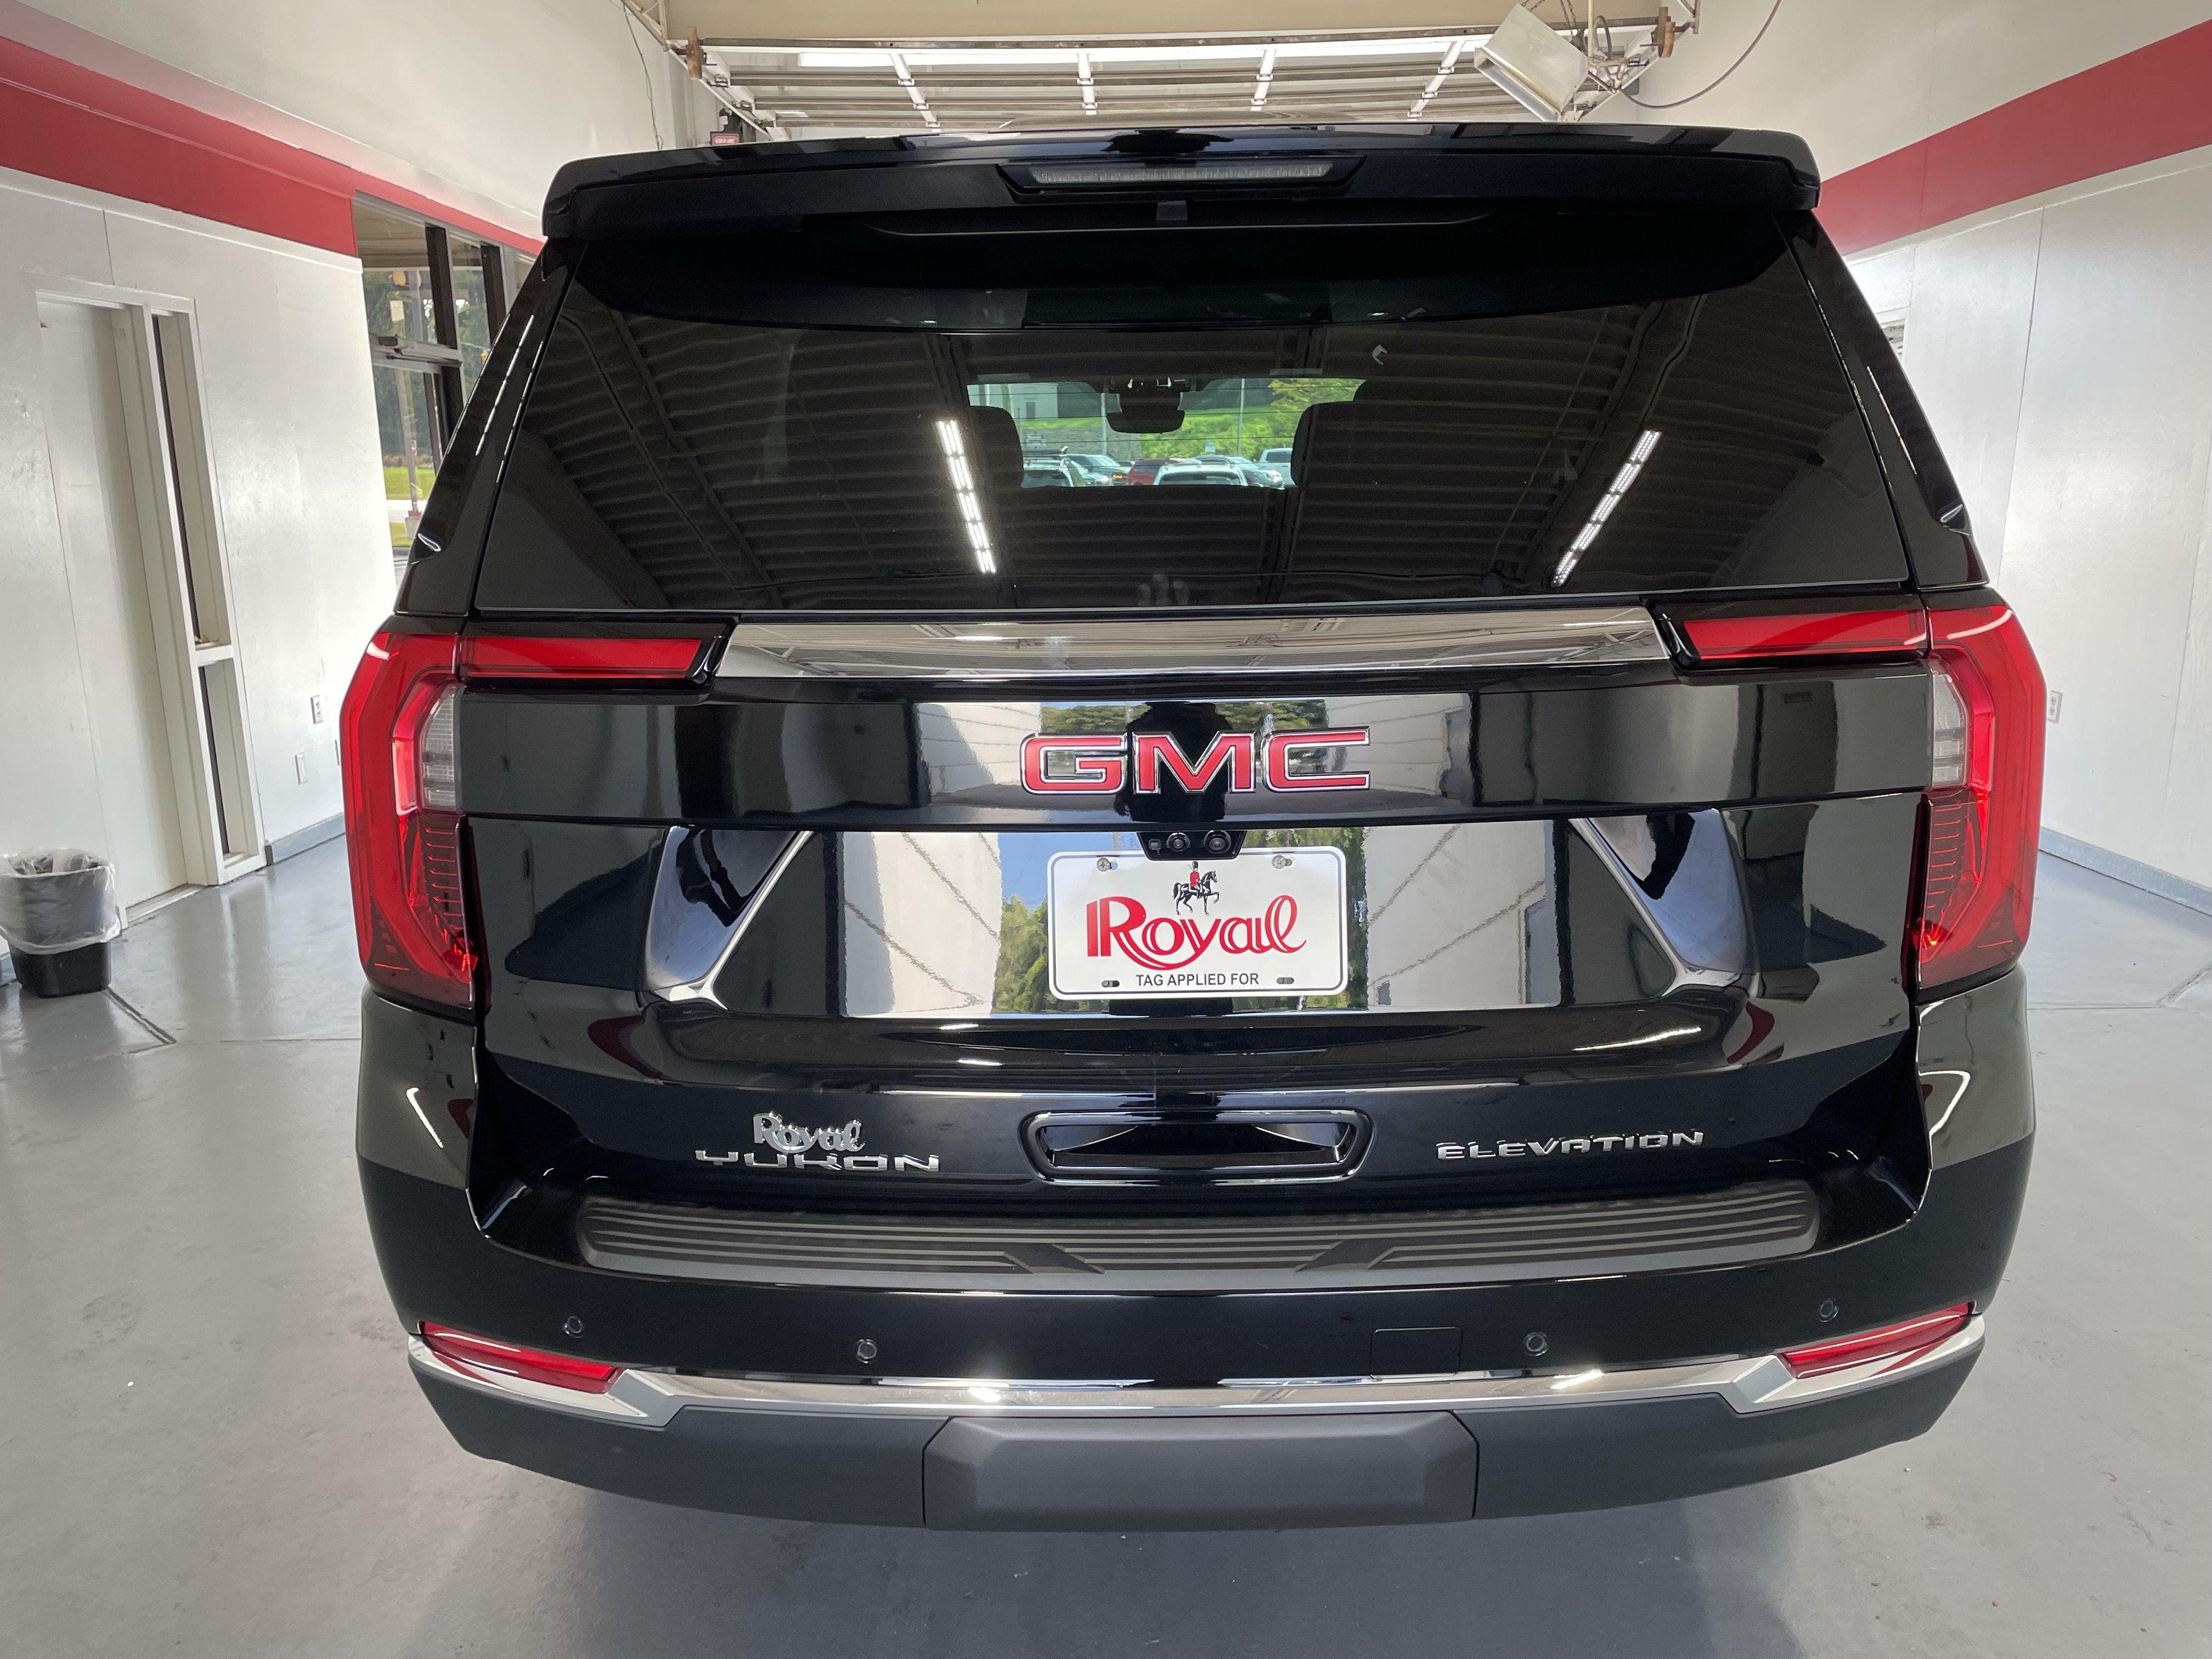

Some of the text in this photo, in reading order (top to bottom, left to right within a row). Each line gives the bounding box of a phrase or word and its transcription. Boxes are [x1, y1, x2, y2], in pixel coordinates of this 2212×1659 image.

[1019, 725, 1370, 795] GMC
[1086, 895, 1307, 971] Royal
[1136, 973, 1260, 986] TAG APPLIED FOR
[753, 1111, 866, 1153] Royal
[1436, 1130, 1704, 1160] ELEVATION
[695, 1150, 939, 1172] YUKON
